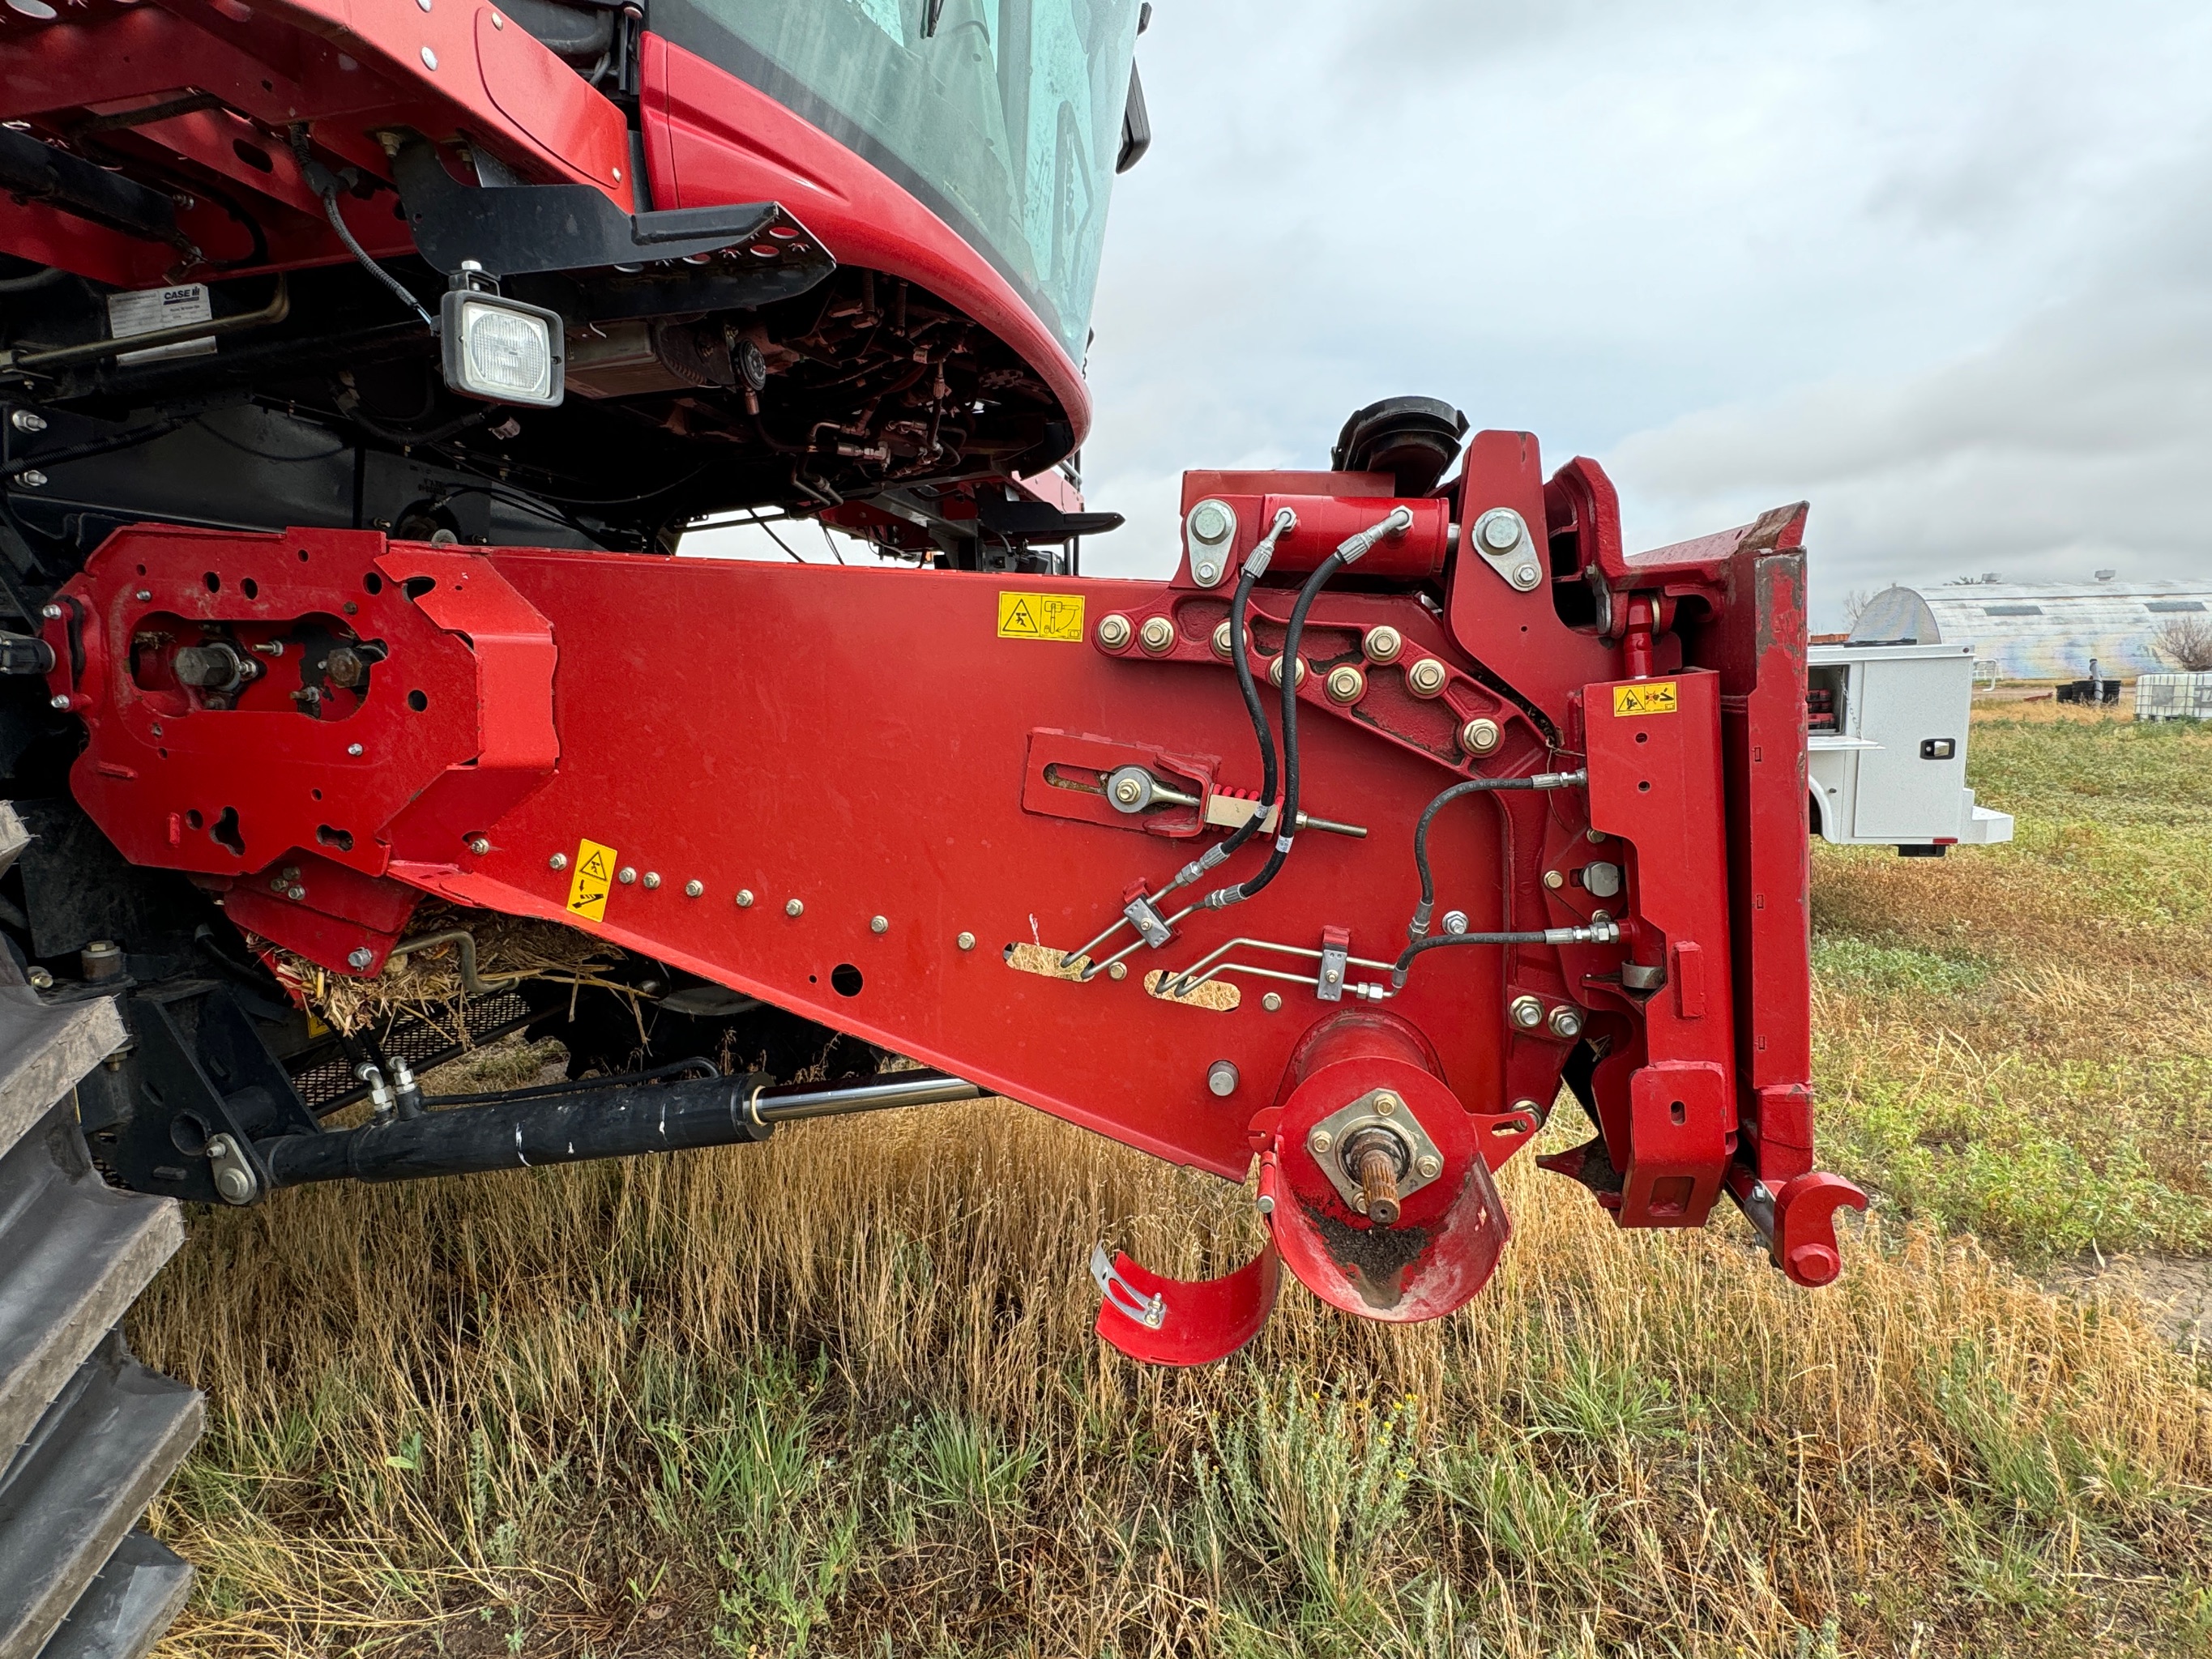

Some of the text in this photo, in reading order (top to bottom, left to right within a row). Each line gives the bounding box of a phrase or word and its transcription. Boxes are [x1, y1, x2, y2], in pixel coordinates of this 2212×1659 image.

[164, 289, 190, 300] CASE
[1442, 789, 1457, 801] MADE
[1433, 800, 1441, 808] IN
